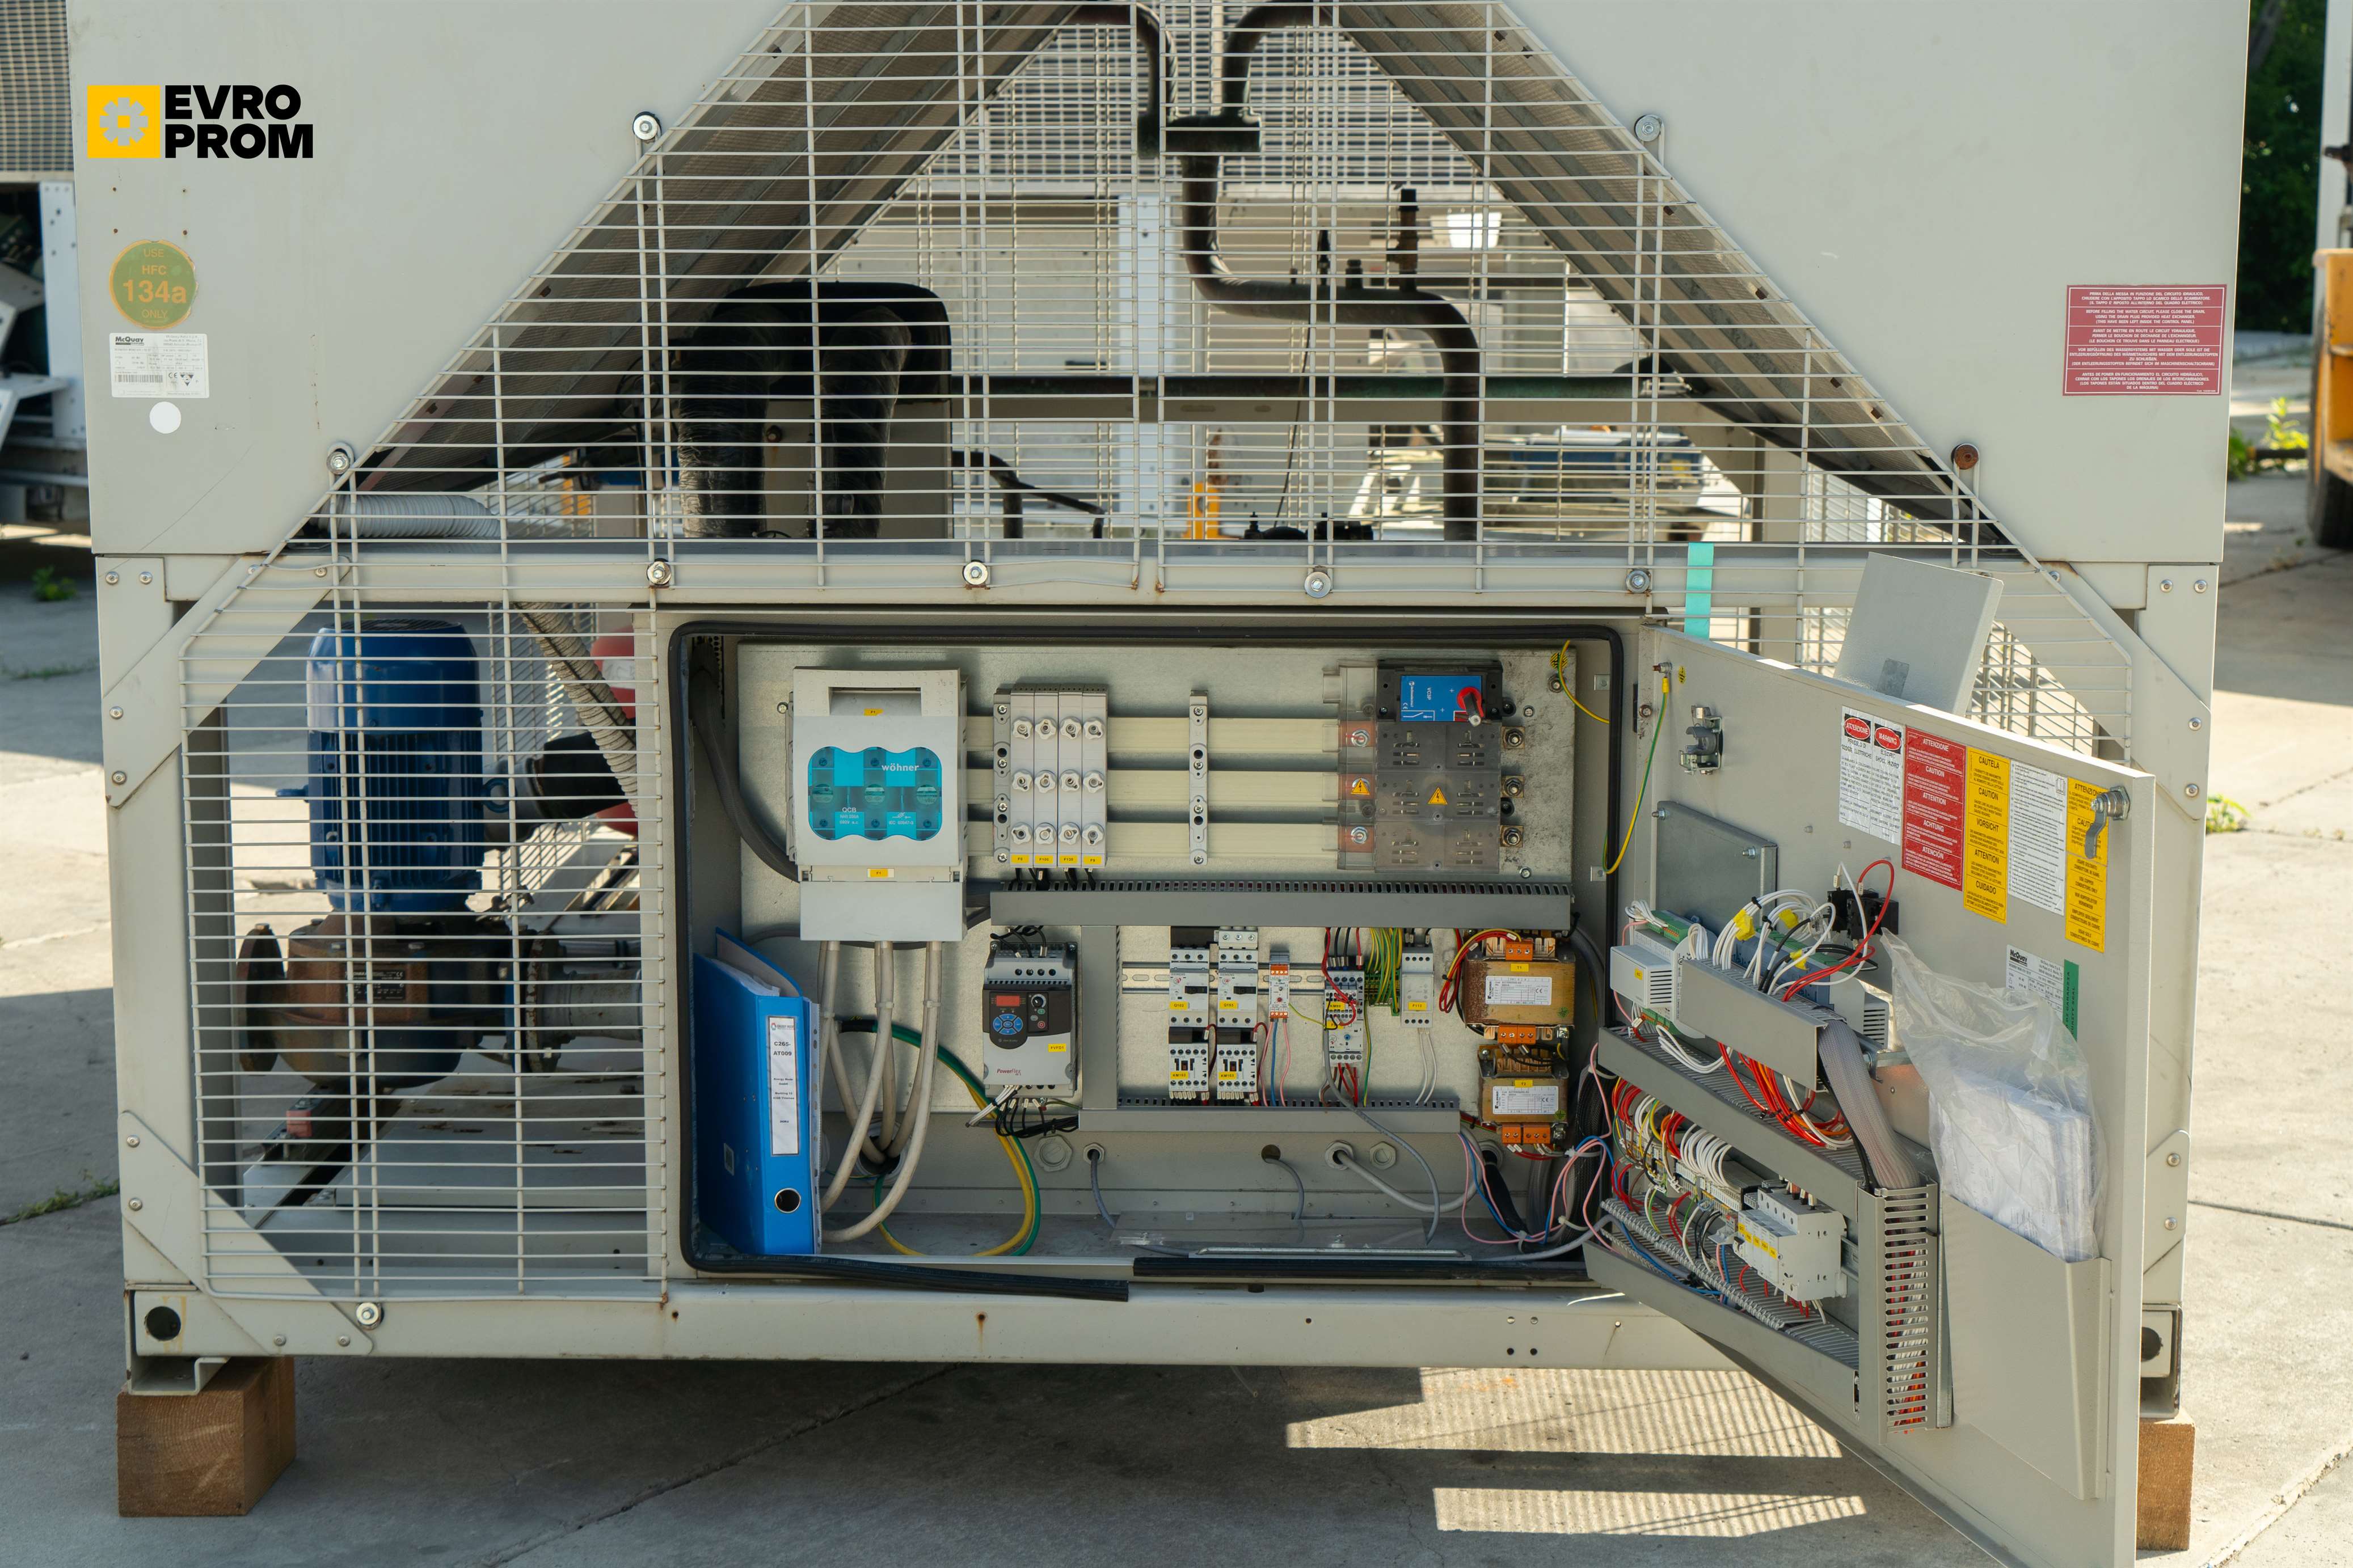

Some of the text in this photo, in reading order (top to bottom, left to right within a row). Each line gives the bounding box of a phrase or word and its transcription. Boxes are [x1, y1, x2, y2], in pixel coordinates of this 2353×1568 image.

[143, 248, 164, 257] USE
[142, 265, 167, 275] HFC
[123, 279, 187, 303] 134a
[142, 309, 168, 318] ONLY
[1879, 732, 1897, 745] WARNING
[1923, 738, 1949, 752] ATTENZIONE
[1979, 756, 2000, 769] CAUTELA
[1925, 766, 1945, 778] CAUTION
[1979, 787, 1998, 800] CAUTION
[2074, 783, 2102, 796] ATTENZIO
[1922, 792, 1946, 806] ATTENTION
[1923, 819, 1944, 832] ACHTUNG
[1976, 818, 1999, 832] VORSICHT
[1922, 846, 1943, 860] ATENCIÓN
[1974, 849, 2000, 865] ATTENTION
[1976, 880, 1996, 895] CUIDADO
[2010, 949, 2027, 962] McQuay
